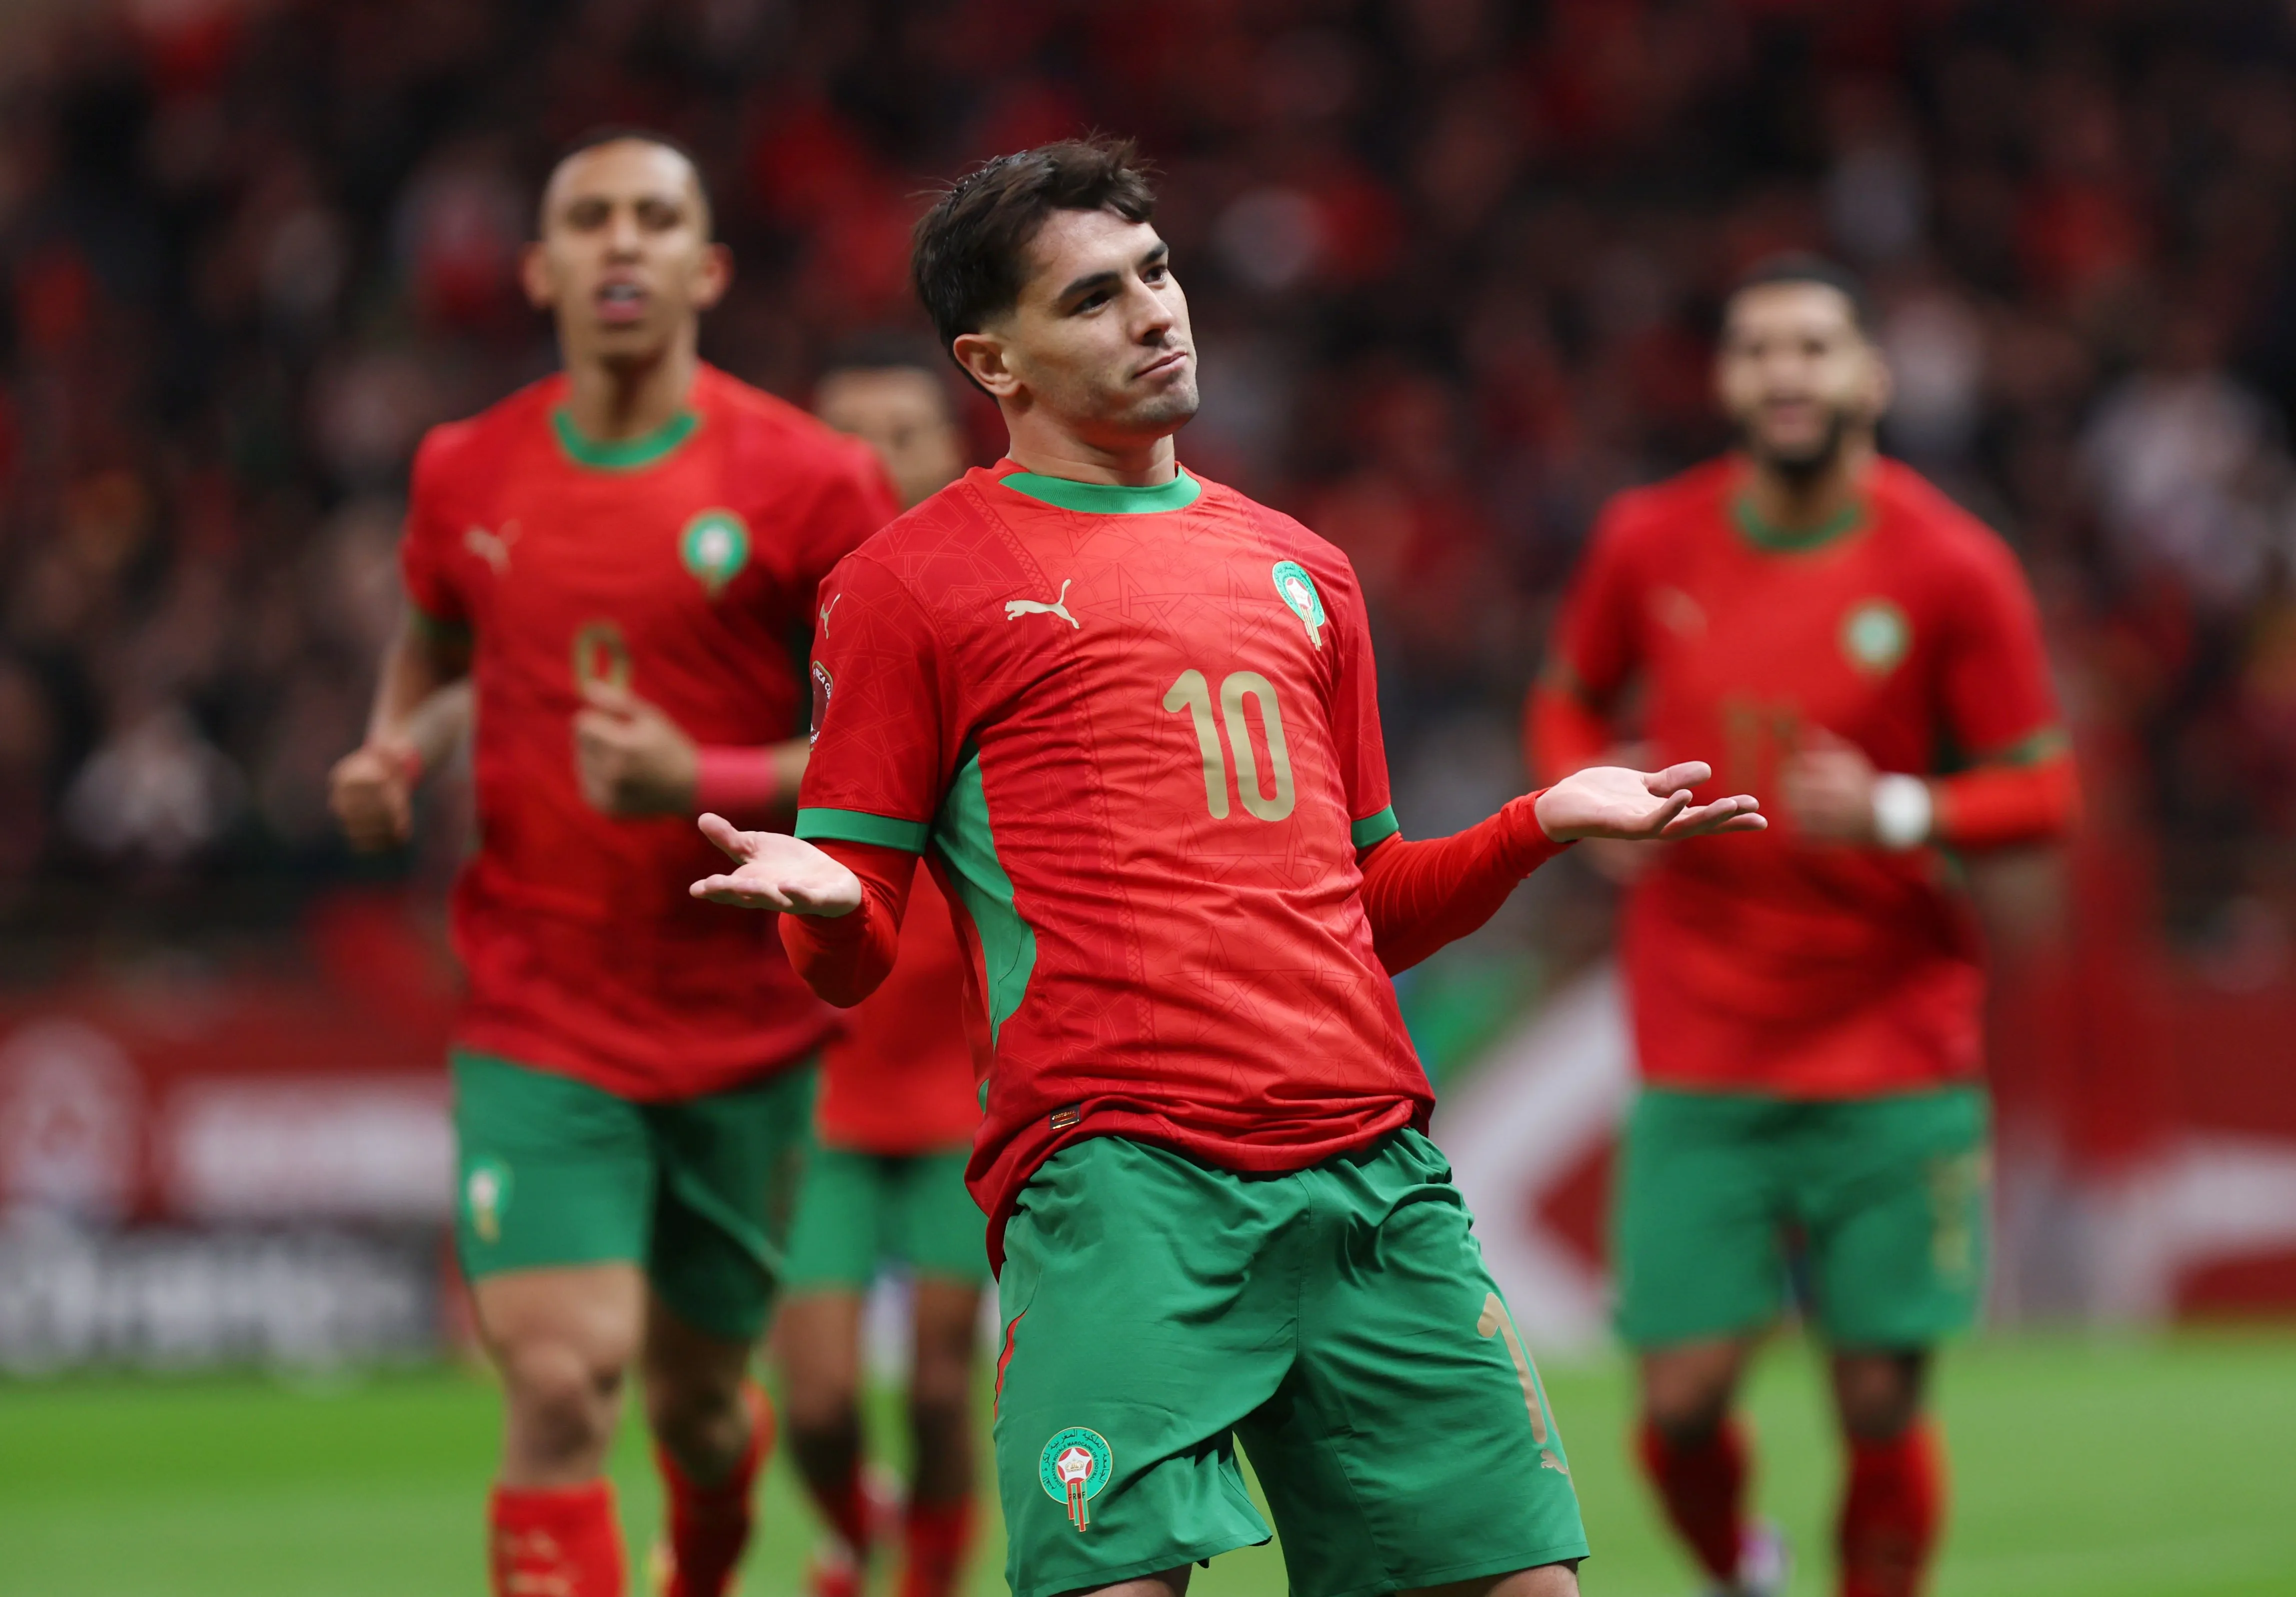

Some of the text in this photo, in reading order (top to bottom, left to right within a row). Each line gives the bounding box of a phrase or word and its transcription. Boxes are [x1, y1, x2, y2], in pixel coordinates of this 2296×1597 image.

[1163, 669, 1295, 821] 10
[1477, 1292, 1559, 1444] 1
[1053, 1444, 1066, 1461] ROYALE
[1067, 1441, 1094, 1452] MAROCAINE
